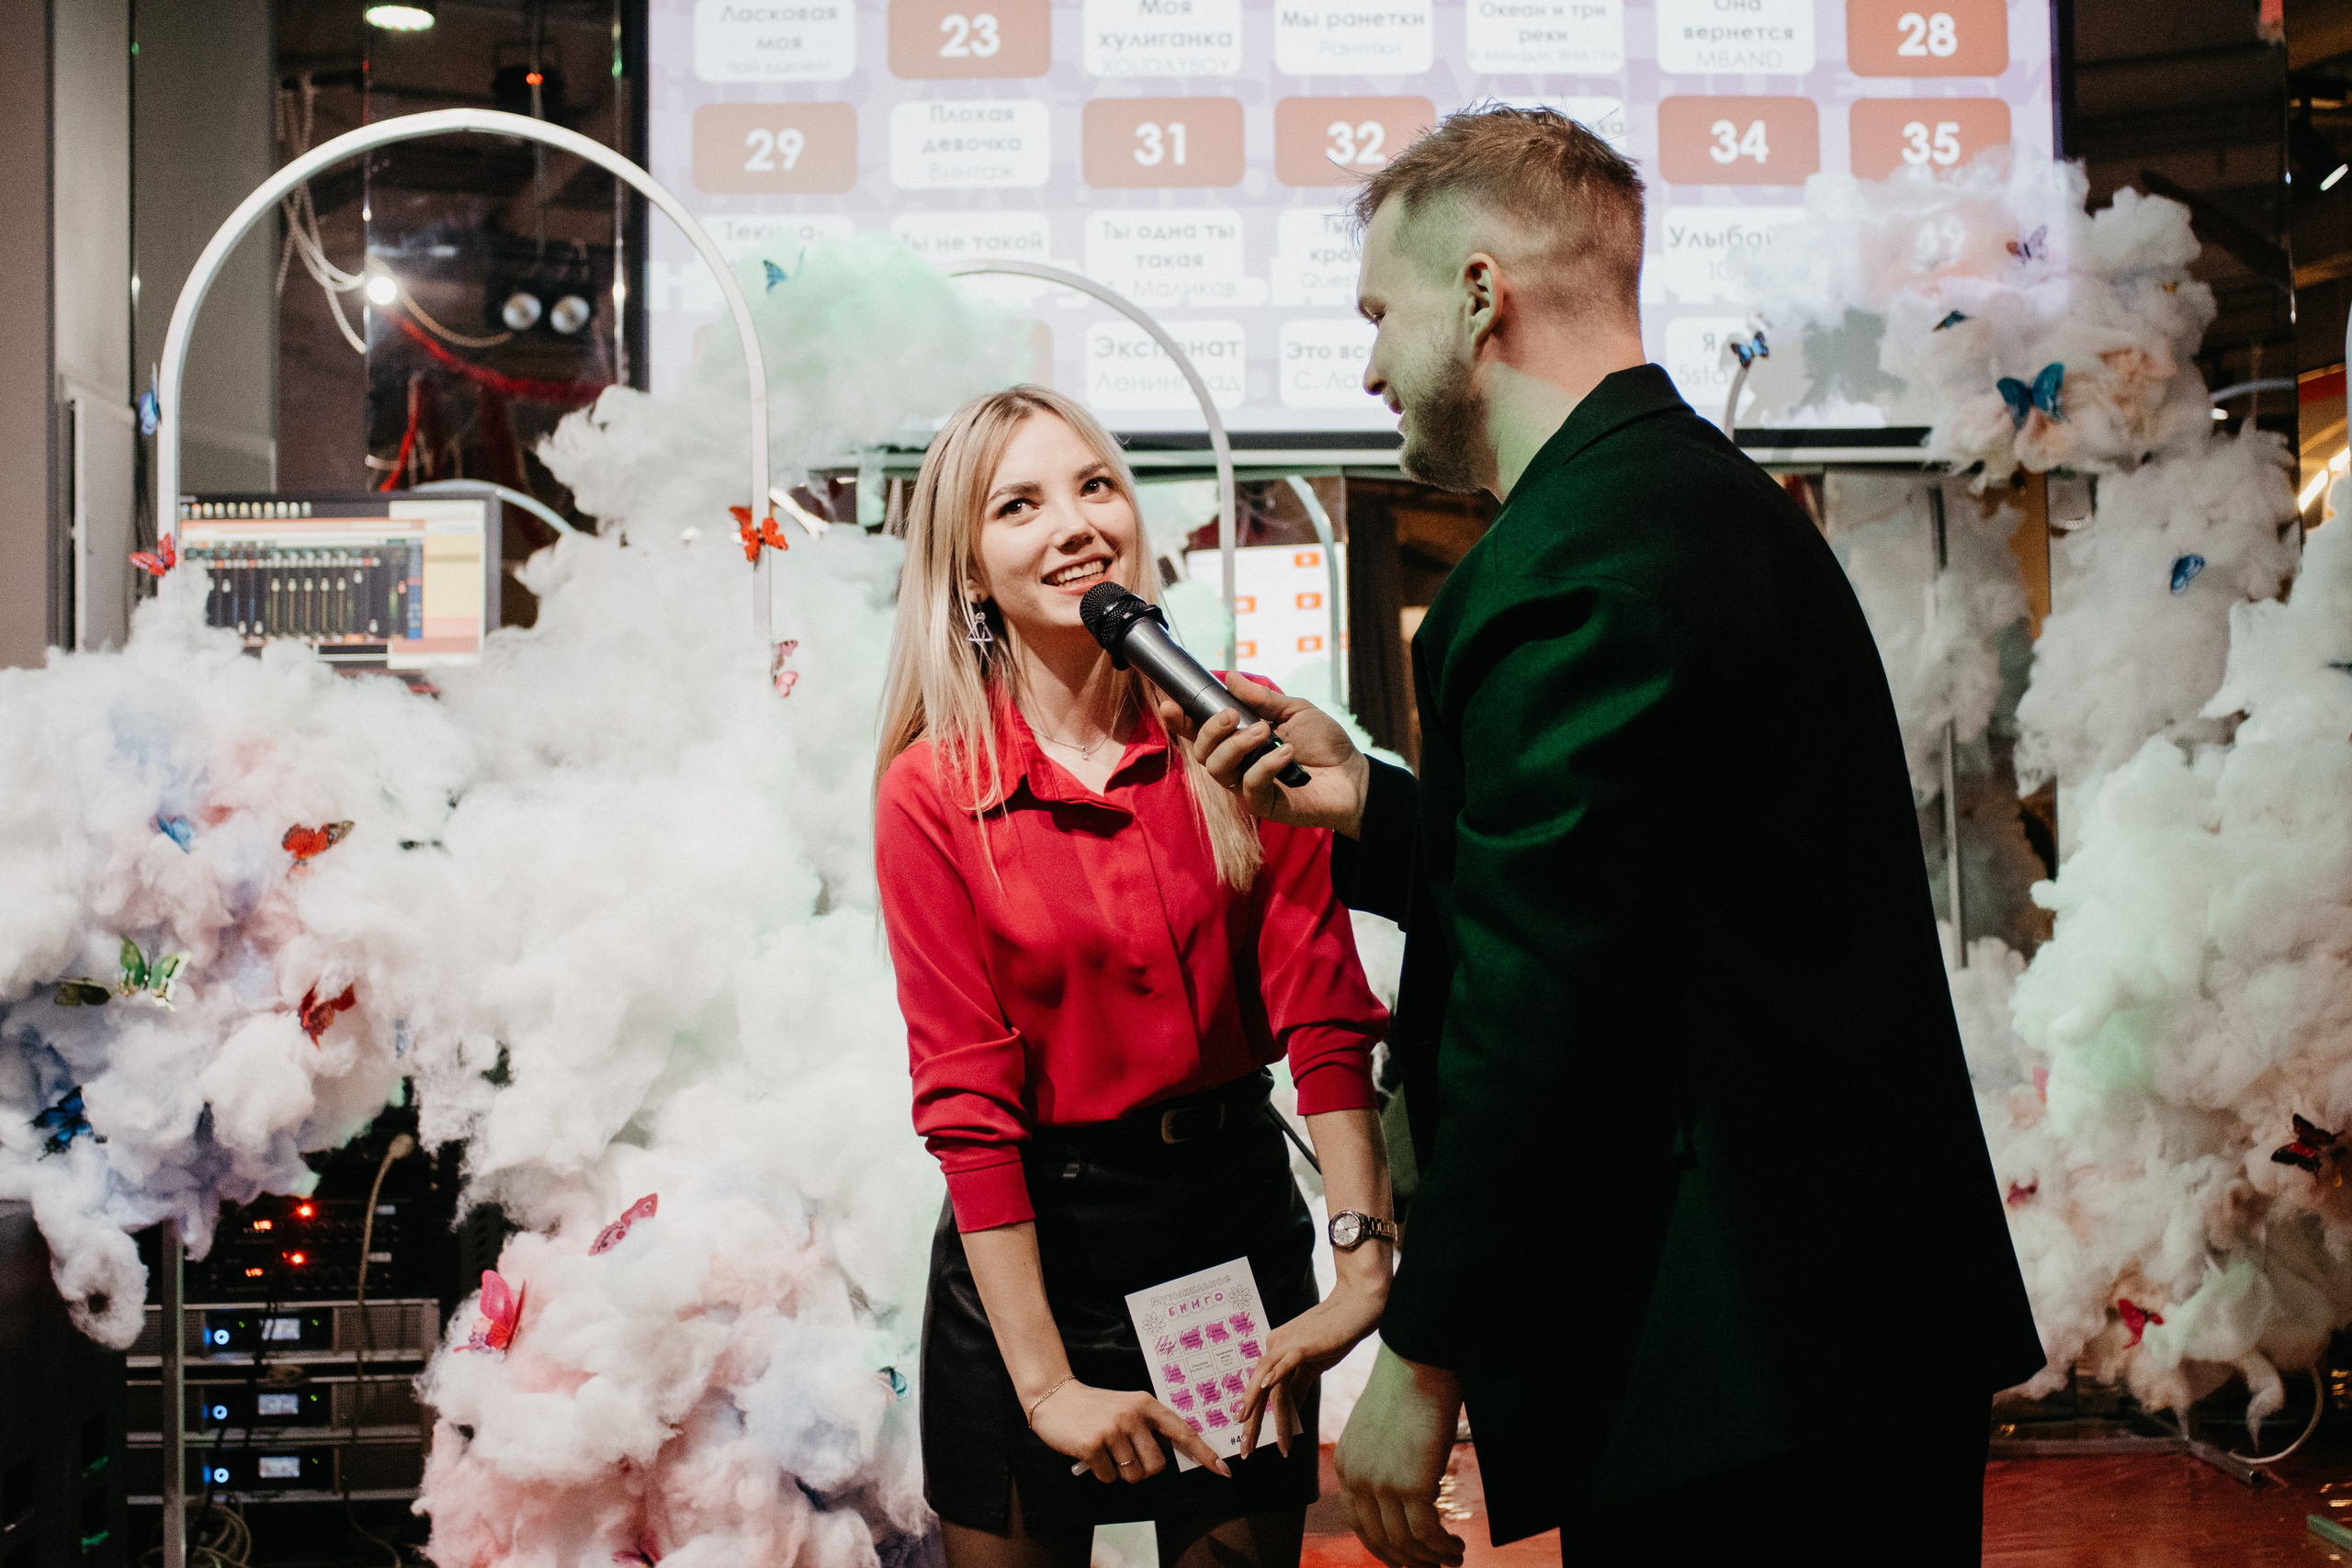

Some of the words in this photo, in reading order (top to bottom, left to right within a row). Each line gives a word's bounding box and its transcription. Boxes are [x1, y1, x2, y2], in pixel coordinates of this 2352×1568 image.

[720, 4, 838, 22] Ласковая
[1138, 0, 1193, 16] Моя
[1479, 2, 1546, 17] Океан
[1571, 6, 1607, 19] три
[1281, 11, 1318, 28] Мы
[1327, 12, 1426, 30] ранетки
[756, 36, 802, 51] моя
[939, 13, 1001, 57] 23
[1098, 31, 1233, 52] хулиганка
[1518, 29, 1569, 45] реки
[1683, 26, 1795, 43] вернется
[1897, 12, 1958, 57] 28
[1695, 50, 1783, 69] MBAND
[930, 105, 1015, 123] Плохая
[743, 128, 806, 172] 29
[922, 137, 1023, 154] девочка
[1134, 121, 1186, 166] 31
[1326, 120, 1387, 165] 32
[1710, 119, 1770, 164] 34
[1901, 121, 1962, 165] 35
[930, 162, 1016, 181] Винтаж
[900, 232, 929, 251] Ты
[936, 235, 965, 251] не
[974, 231, 1043, 252] такой
[1102, 221, 1130, 240] Ты
[1138, 225, 1196, 242] одна
[1204, 224, 1236, 240] ты
[1136, 254, 1204, 269] такая
[1285, 341, 1331, 360] Это
[1701, 332, 1716, 353] Я
[1150, 1275, 1231, 1307] Музыкальное
[1168, 1292, 1224, 1317] БИНГО
